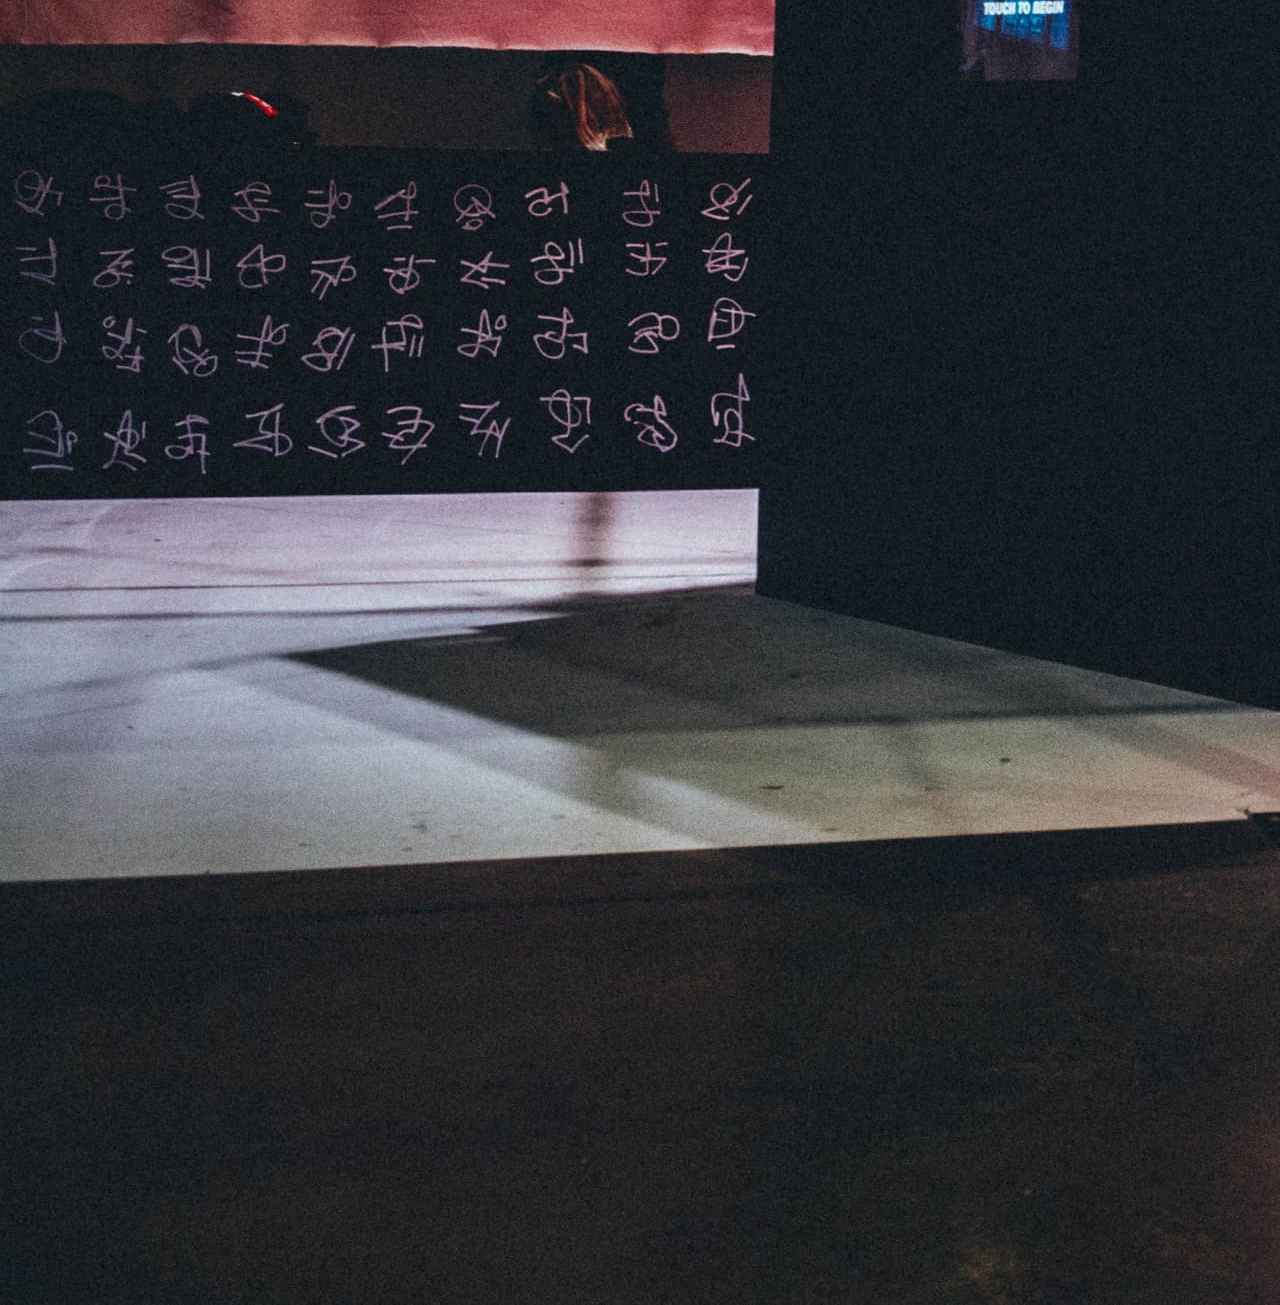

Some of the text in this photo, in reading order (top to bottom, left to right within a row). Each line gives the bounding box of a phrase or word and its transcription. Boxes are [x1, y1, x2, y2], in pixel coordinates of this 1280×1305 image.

[983, 0, 1064, 15] TOUCH TO BEGIN
